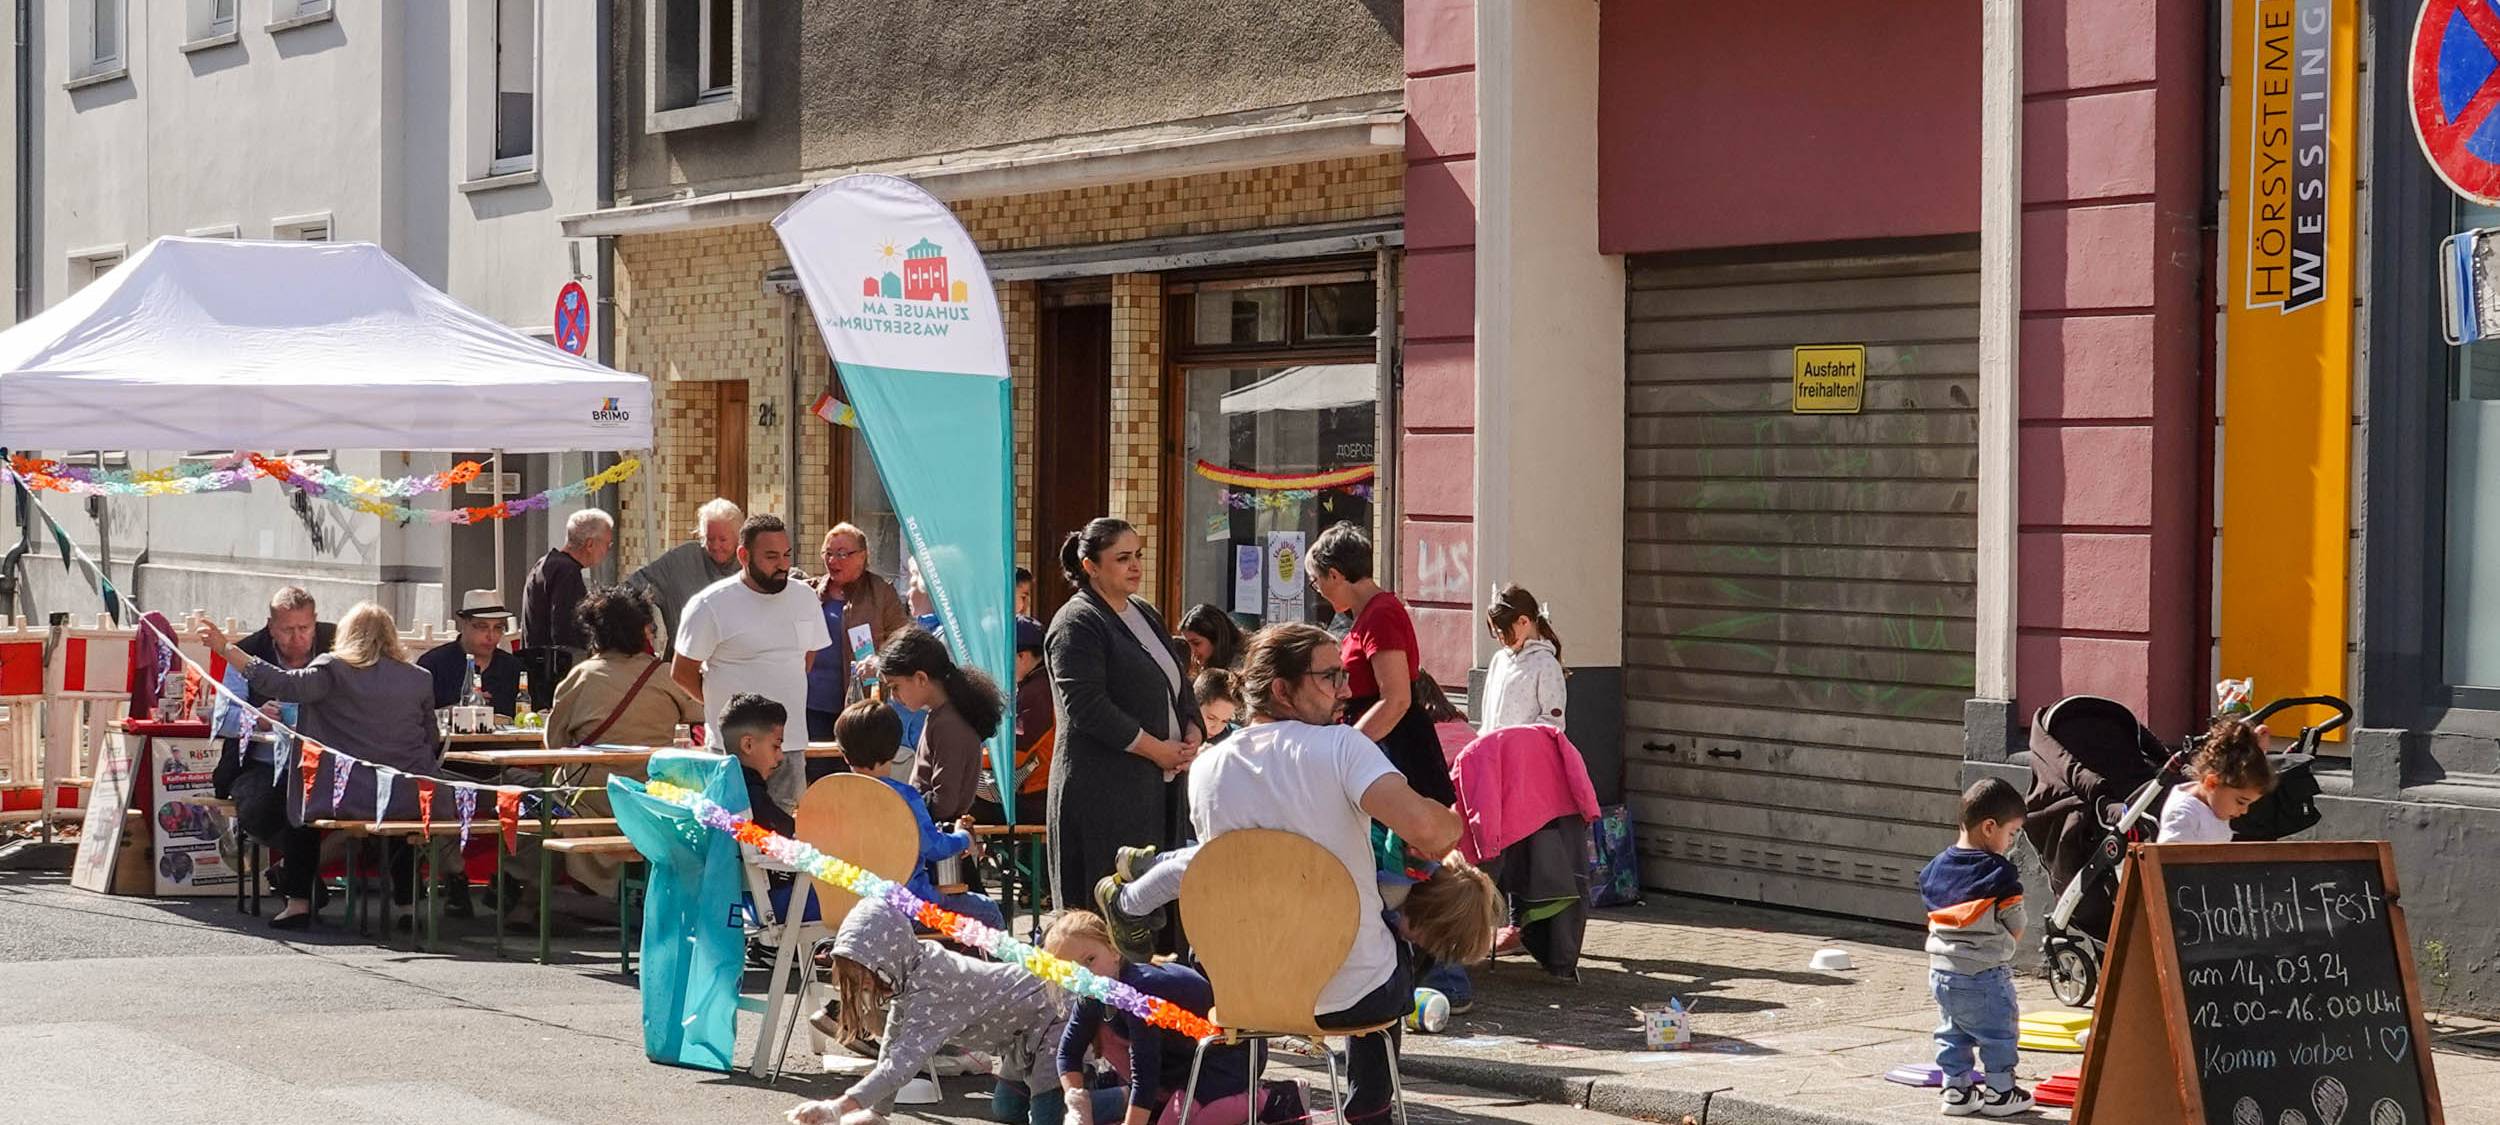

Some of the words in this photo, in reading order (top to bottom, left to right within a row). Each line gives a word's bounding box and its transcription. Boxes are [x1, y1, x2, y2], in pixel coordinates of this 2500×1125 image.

[2255, 10, 2290, 297] HÖRSYSTEME
[2291, 5, 2327, 297] WESSLING
[1804, 361, 1856, 377] Ausfahrt
[1799, 381, 1858, 398] freihalten!
[592, 410, 630, 421] BRIMO
[2188, 967, 2224, 987] am
[2231, 953, 2349, 996] 14.09.24
[2366, 989, 2401, 1015] Uhr
[2203, 1044, 2276, 1078] Komm
